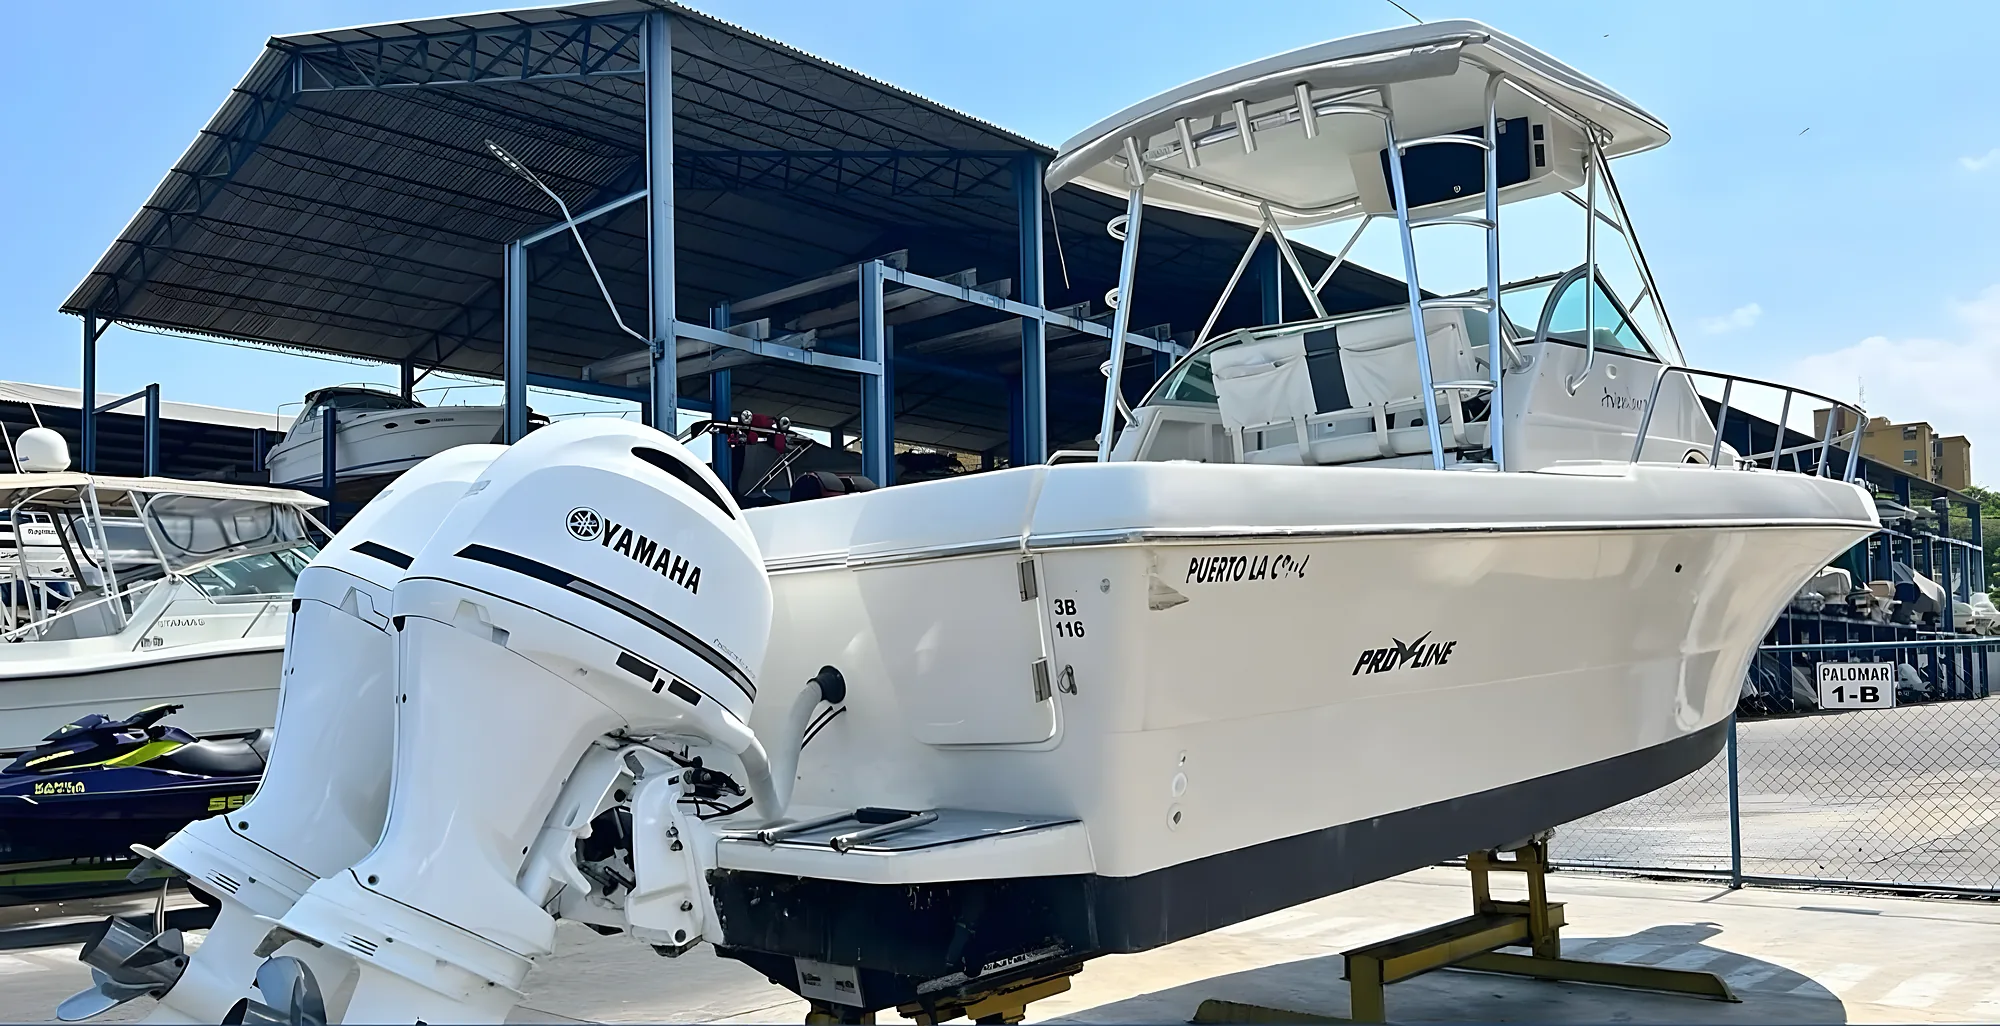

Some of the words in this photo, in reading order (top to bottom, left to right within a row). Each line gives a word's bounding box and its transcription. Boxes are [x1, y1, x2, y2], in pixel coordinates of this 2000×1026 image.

[601, 518, 702, 596] YAMAHA
[1186, 555, 1247, 583] PUERTO
[1248, 555, 1269, 580] LA
[1054, 598, 1077, 616] 3B
[1056, 621, 1085, 638] 116
[1822, 667, 1889, 681] PALOMAR
[1832, 685, 1880, 703] 1-B
